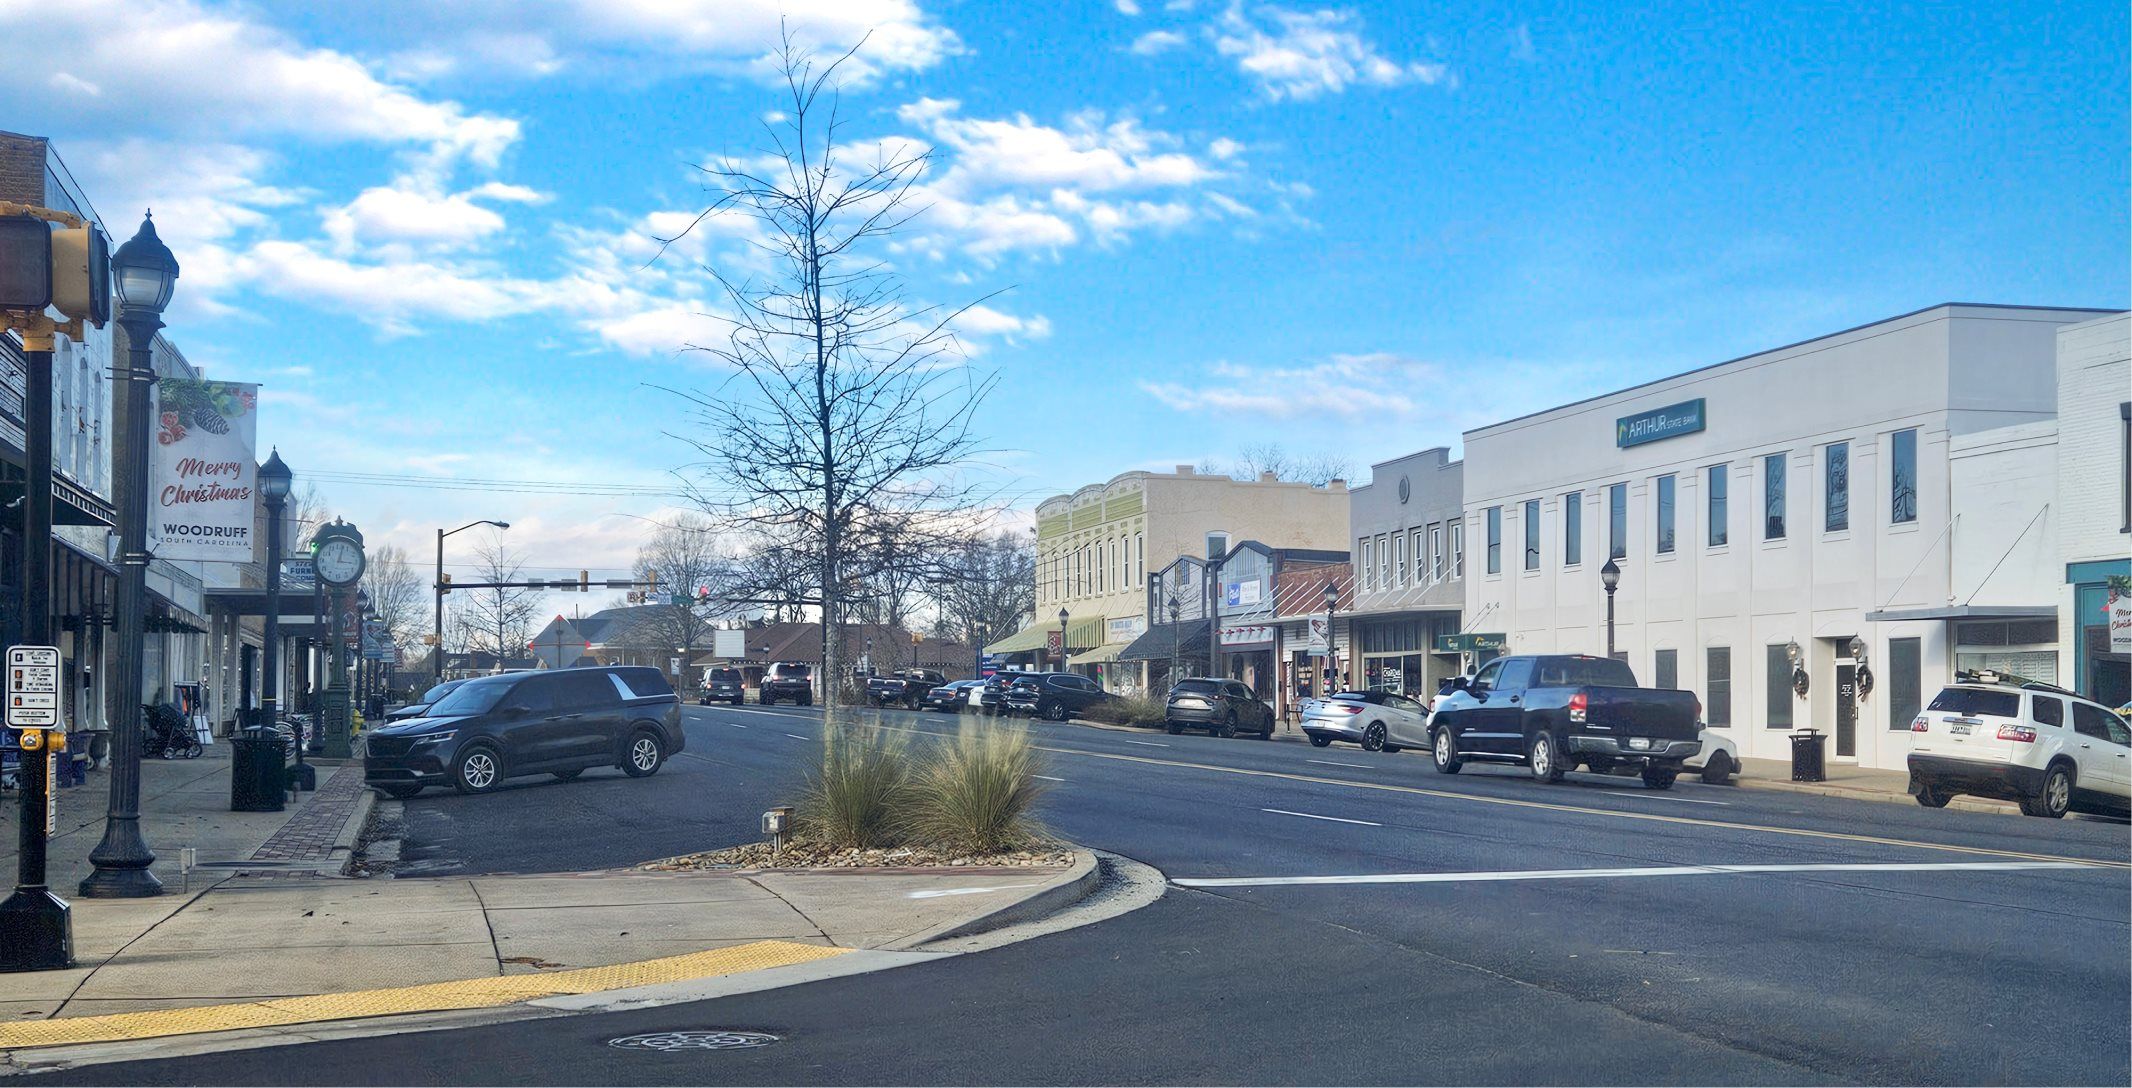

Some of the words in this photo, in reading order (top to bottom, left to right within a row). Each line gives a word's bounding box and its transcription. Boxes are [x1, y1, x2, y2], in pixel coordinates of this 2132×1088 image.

[1628, 415, 1667, 439] ARTHUR
[1667, 417, 1682, 429] STATE
[1683, 414, 1697, 425] BANK
[176, 458, 242, 480] Merry
[160, 481, 252, 507] Christmas
[163, 523, 248, 538] WOODRUFF
